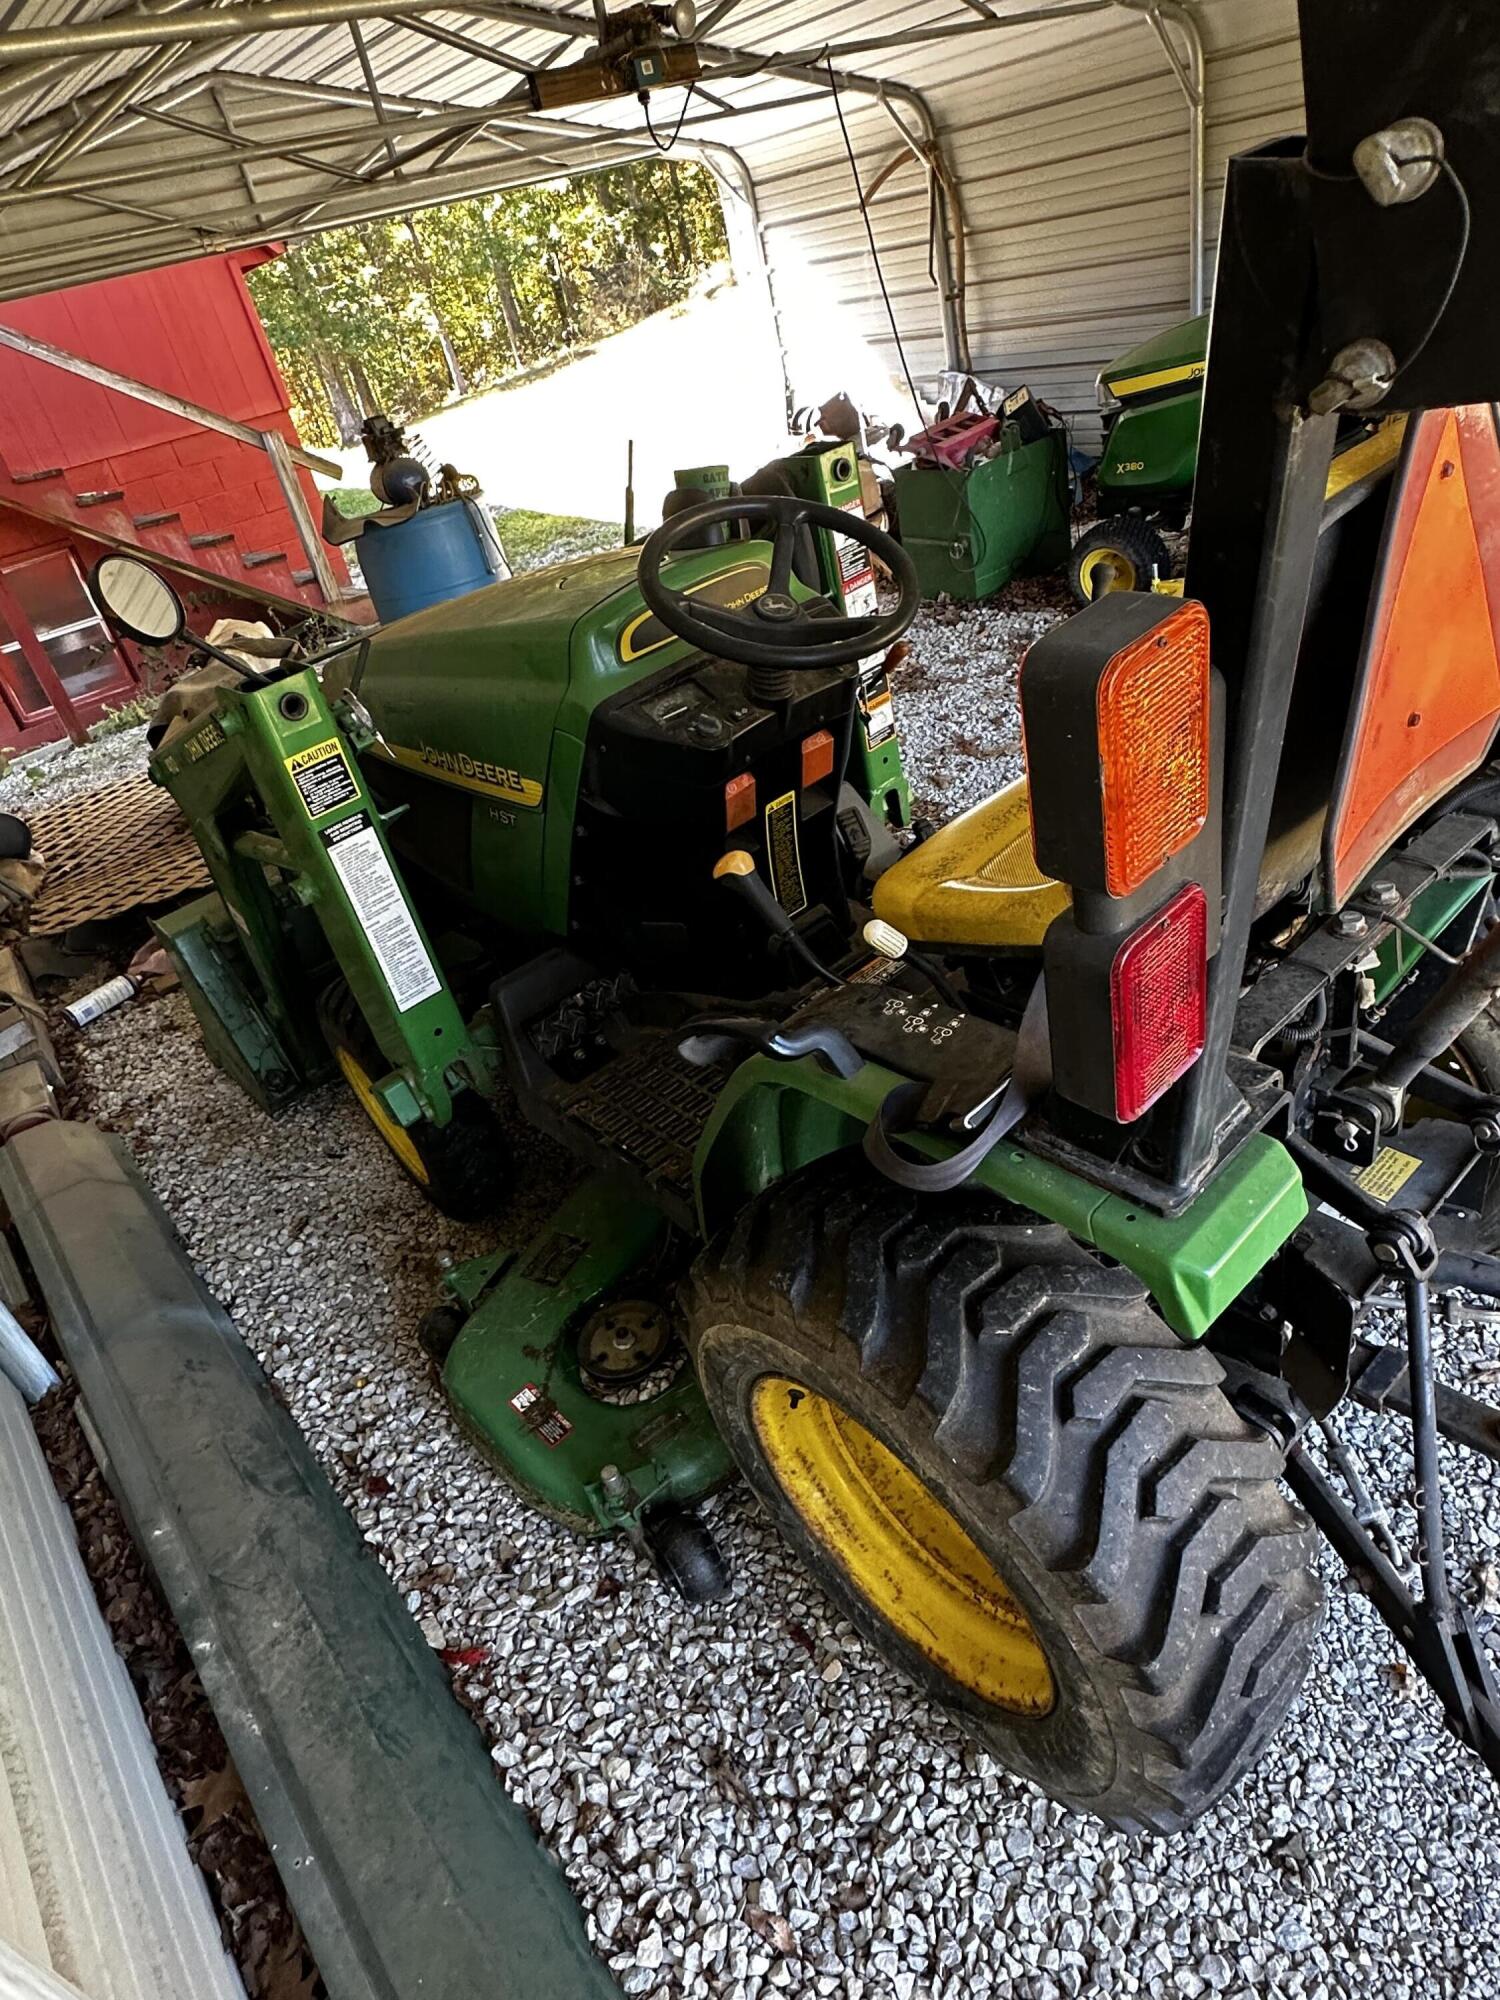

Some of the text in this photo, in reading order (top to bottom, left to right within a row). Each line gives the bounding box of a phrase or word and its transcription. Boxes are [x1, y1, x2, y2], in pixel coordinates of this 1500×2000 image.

[1116, 461, 1145, 474] X380
[300, 742, 339, 765] CAUTION
[419, 740, 524, 791] JOHN DEERE
[488, 807, 518, 826] HST
